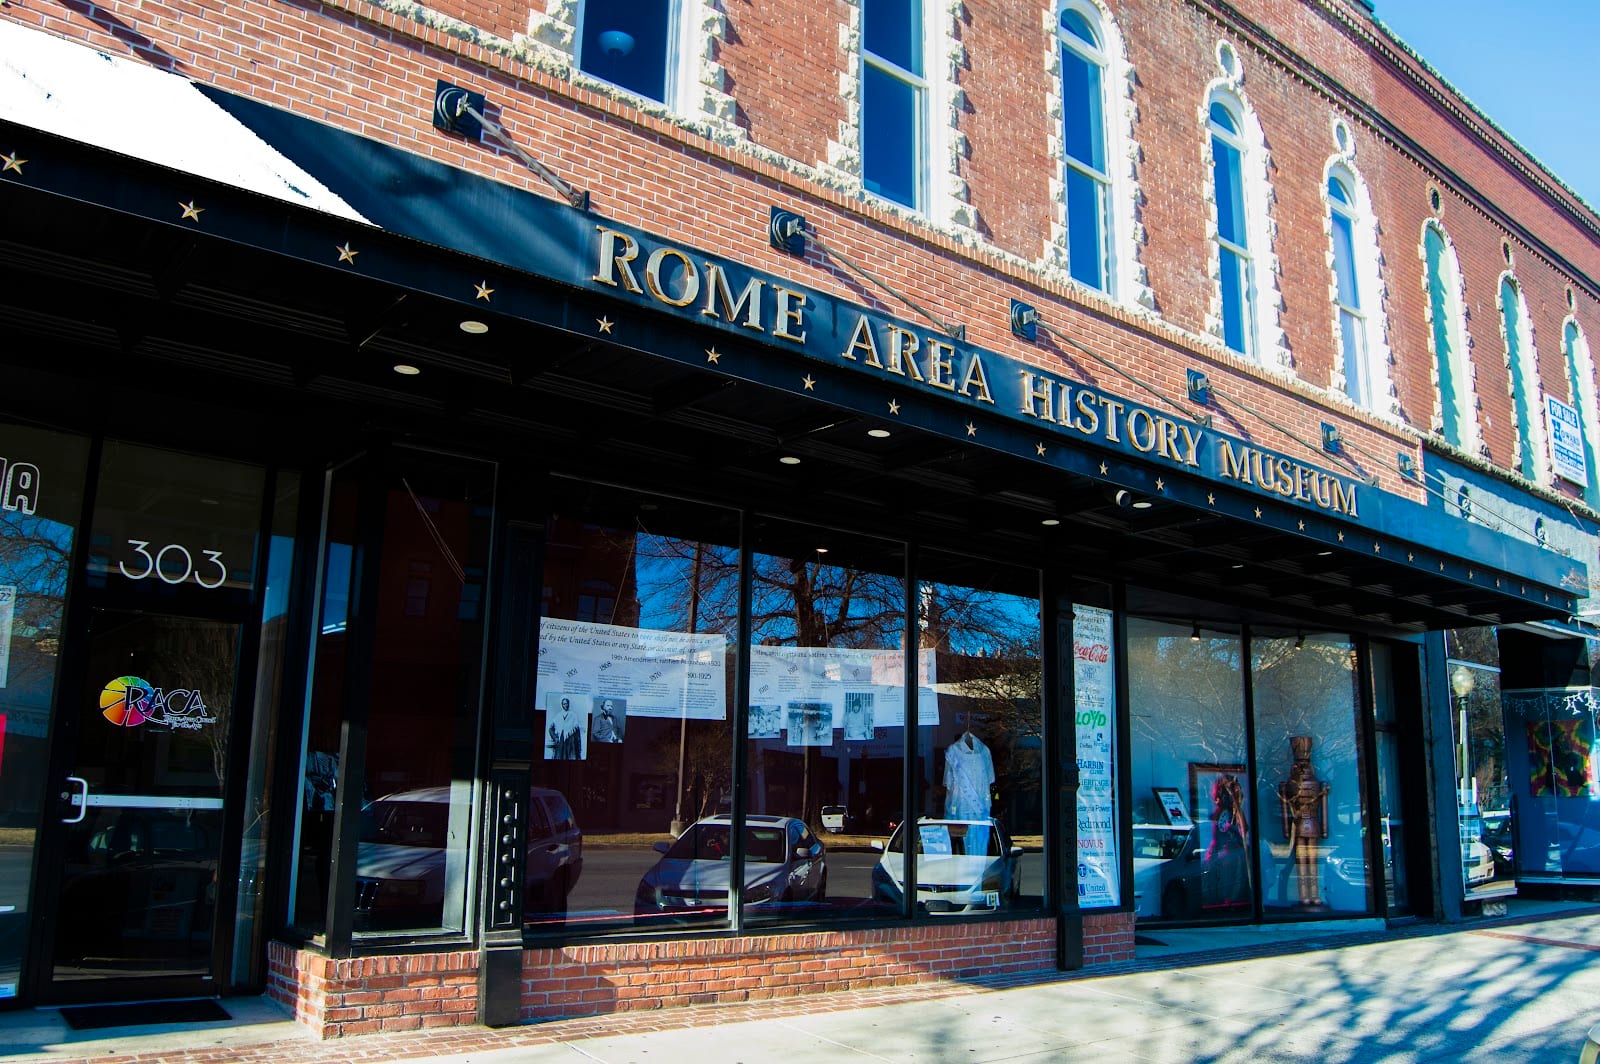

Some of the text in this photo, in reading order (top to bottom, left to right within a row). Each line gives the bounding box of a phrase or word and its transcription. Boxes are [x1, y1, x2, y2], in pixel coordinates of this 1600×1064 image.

[592, 224, 1359, 519] ROME AREA HISTORY MUSEUM
[0, 457, 40, 516] A
[119, 539, 227, 589] 303
[569, 636, 590, 646] United
[591, 638, 611, 647] States
[590, 626, 611, 636] United
[611, 628, 630, 638] States
[125, 685, 208, 718] RACA
[1077, 758, 1104, 770] HARBIN
[1086, 881, 1106, 893] United
